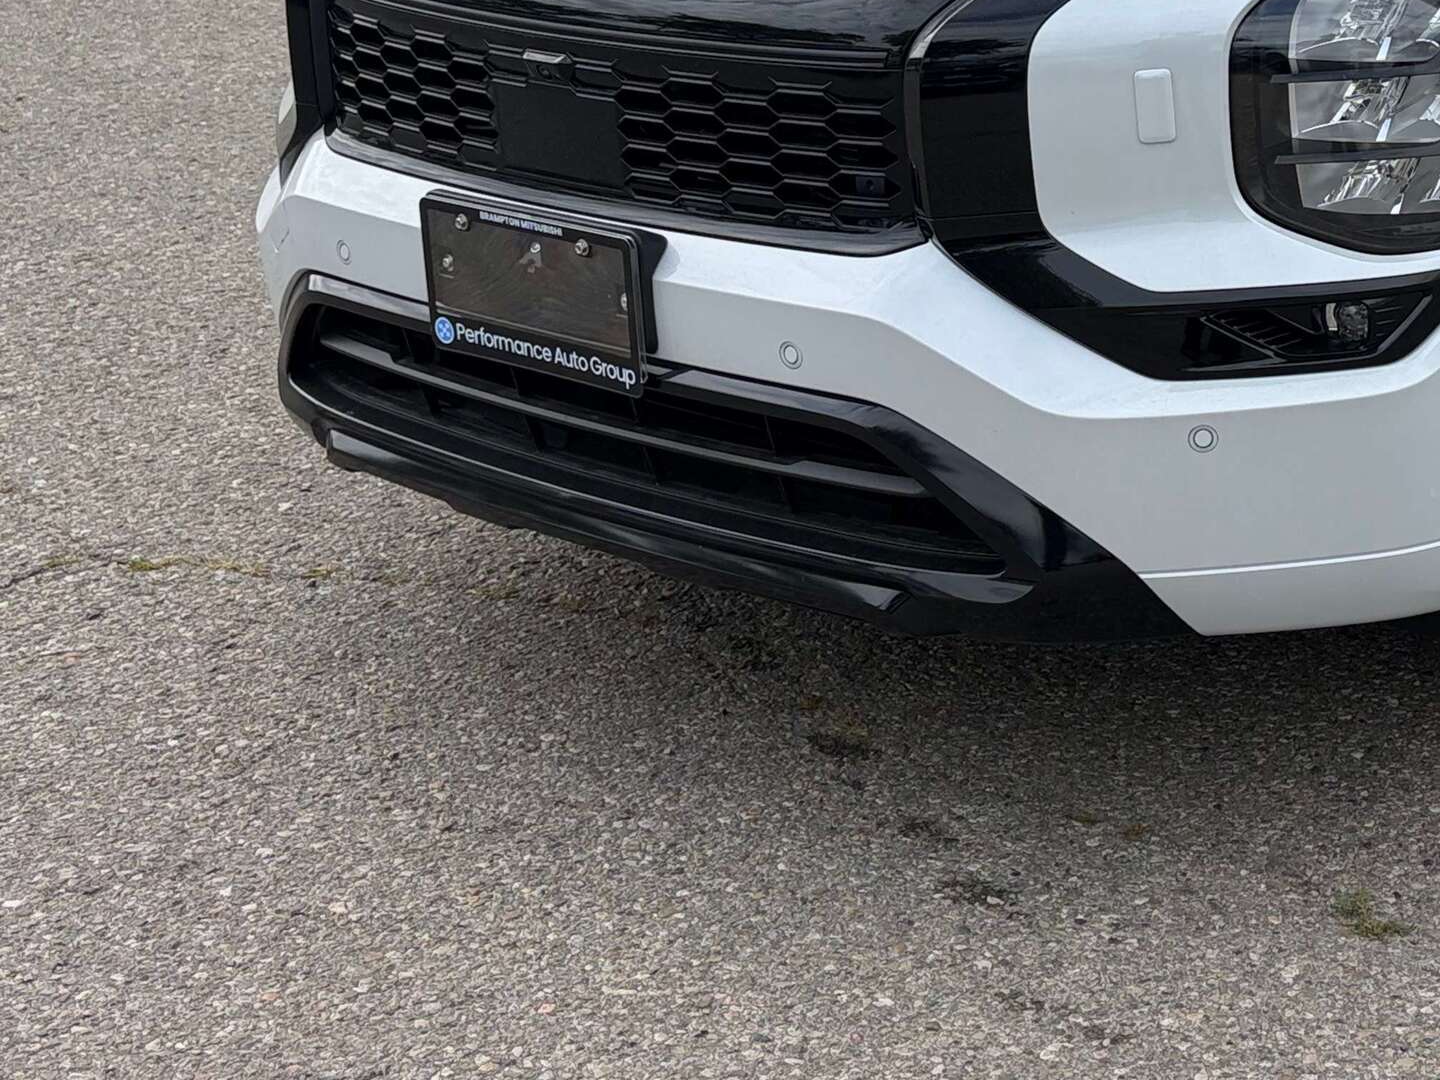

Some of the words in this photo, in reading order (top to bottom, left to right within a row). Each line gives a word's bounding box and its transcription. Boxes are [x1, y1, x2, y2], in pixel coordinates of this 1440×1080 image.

[479, 210, 521, 228] BRAMPTON
[521, 219, 564, 238] MITSUBISHI
[455, 322, 552, 362] Performance
[554, 347, 589, 372] Auto
[589, 356, 637, 390] Group
